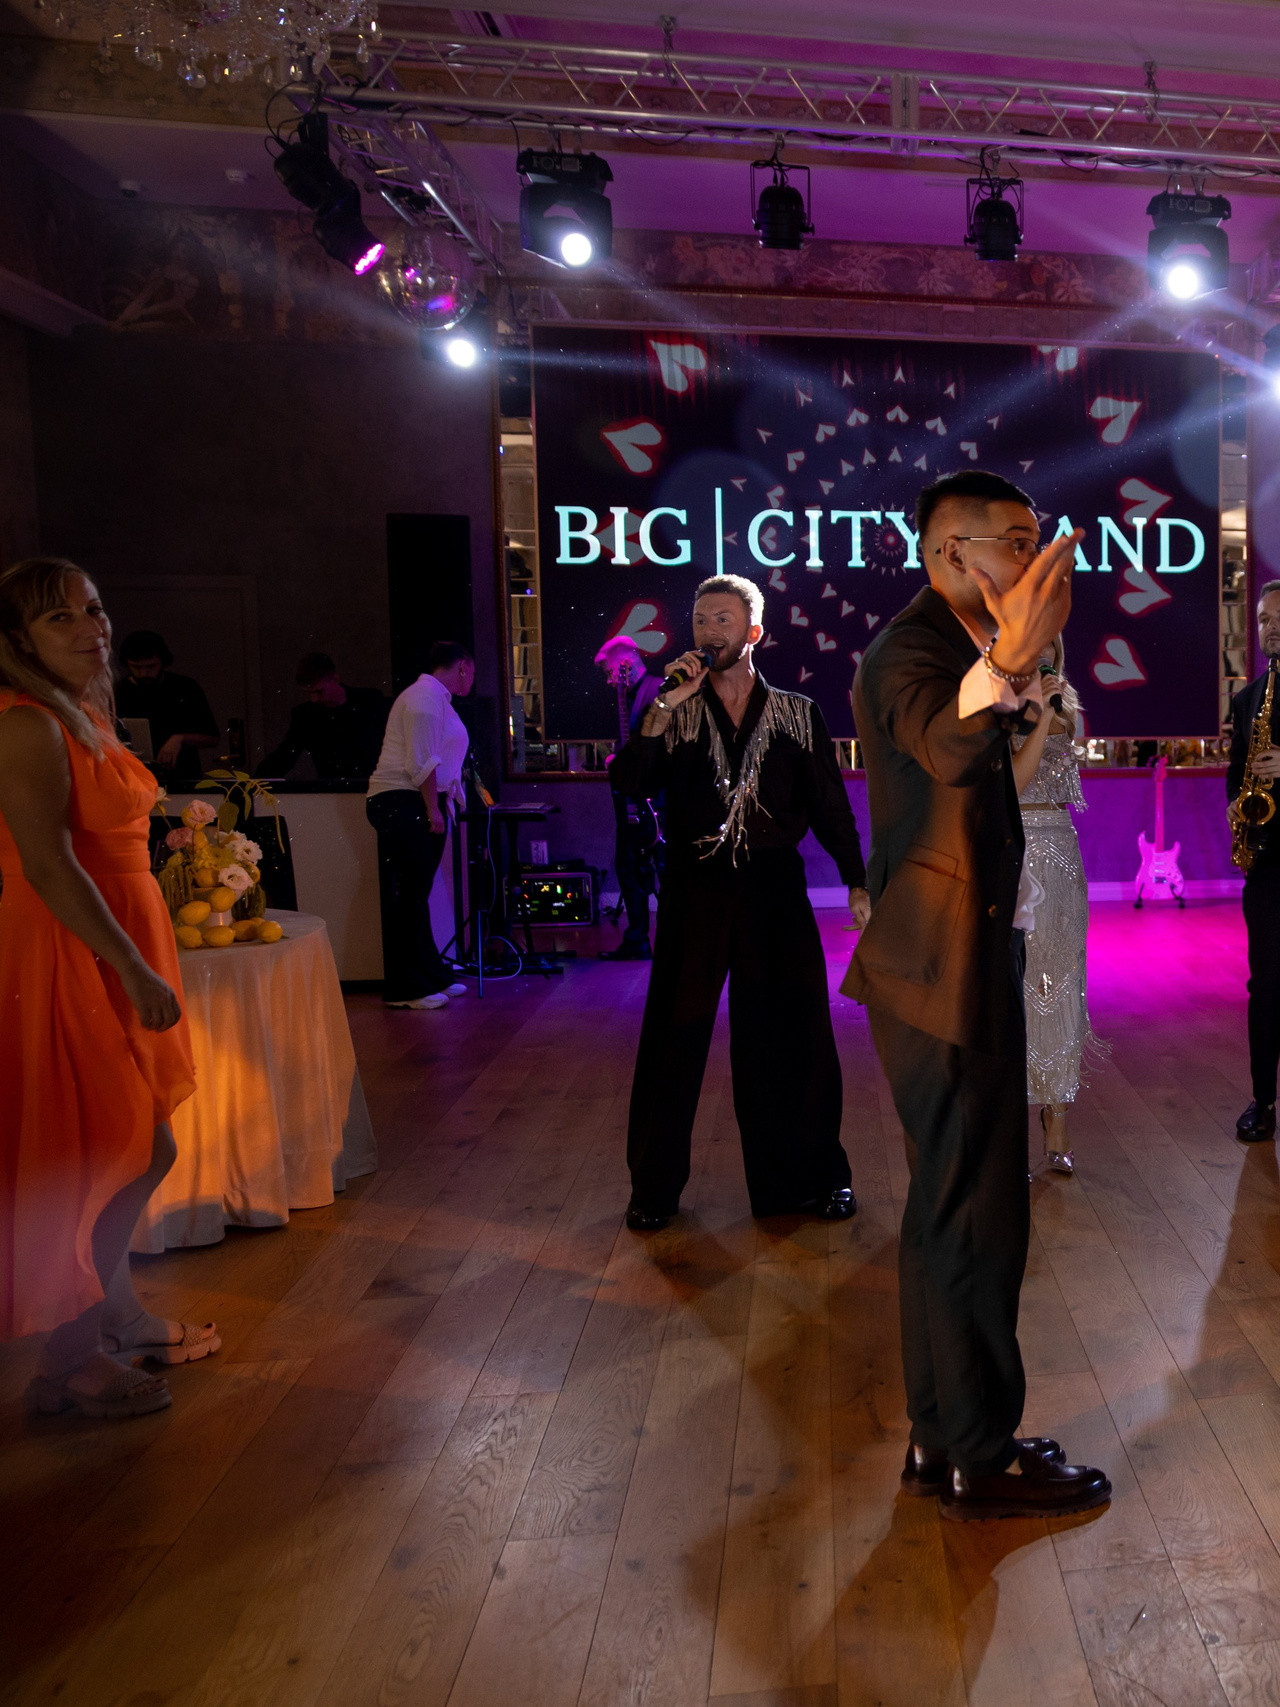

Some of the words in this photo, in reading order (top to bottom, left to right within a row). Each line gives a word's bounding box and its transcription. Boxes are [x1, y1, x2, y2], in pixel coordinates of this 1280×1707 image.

[554, 505, 692, 566] BIG
[747, 508, 921, 569] CITY
[1052, 514, 1206, 573] AND
